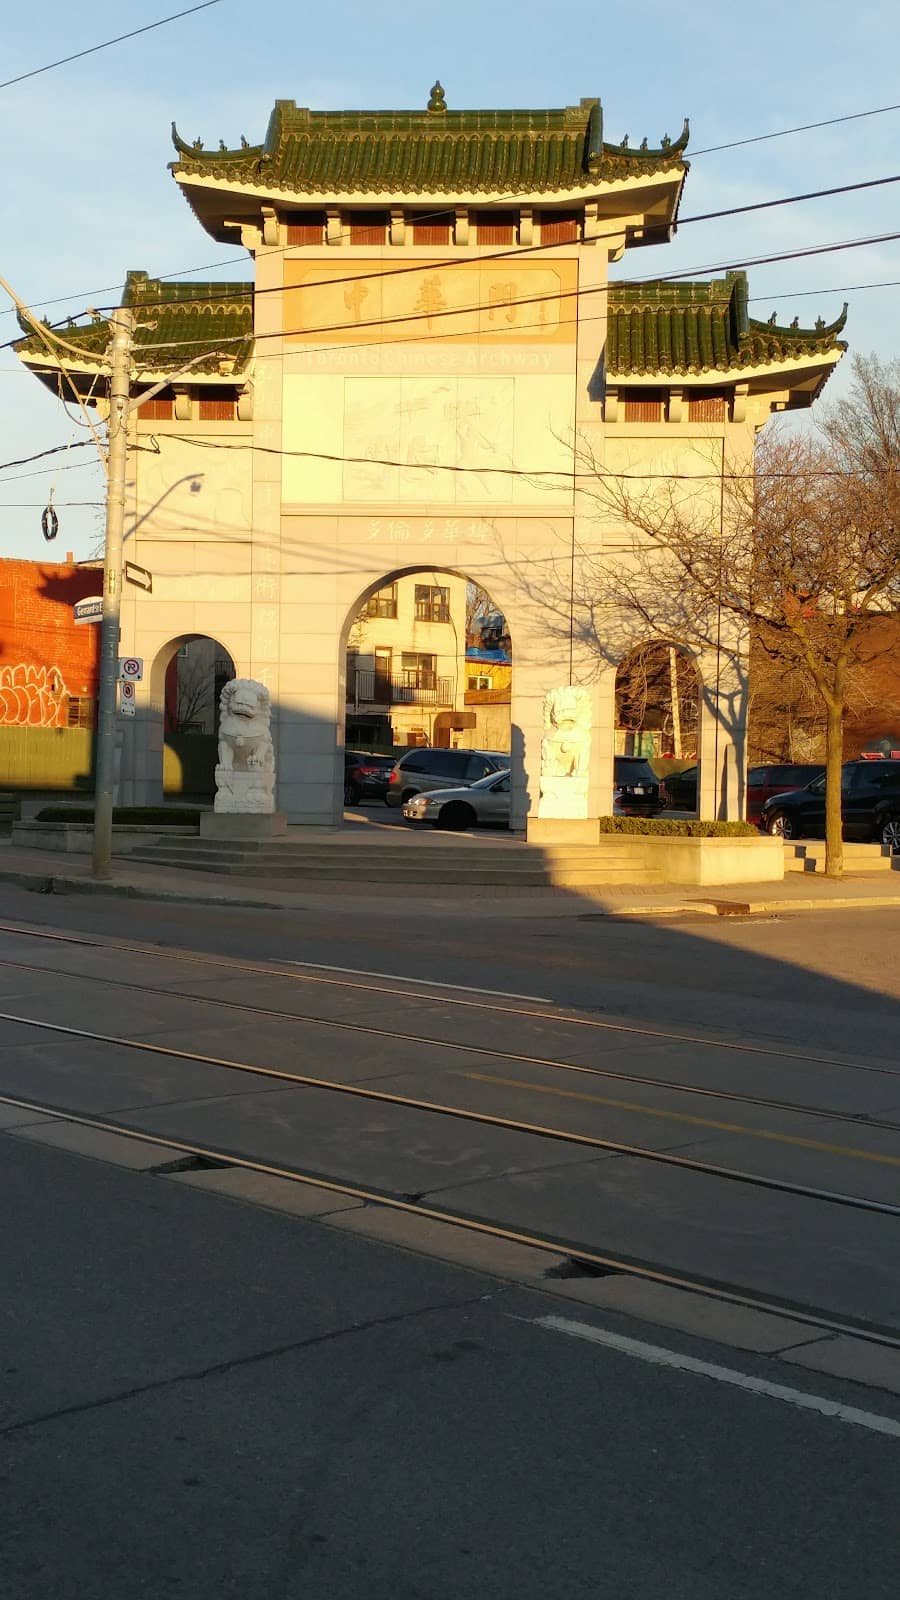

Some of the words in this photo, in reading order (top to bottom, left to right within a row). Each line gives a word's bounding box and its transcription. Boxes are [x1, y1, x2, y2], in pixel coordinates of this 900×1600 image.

[305, 350, 377, 368] Toronto
[385, 349, 456, 368] Chinese
[467, 349, 553, 370] Archway
